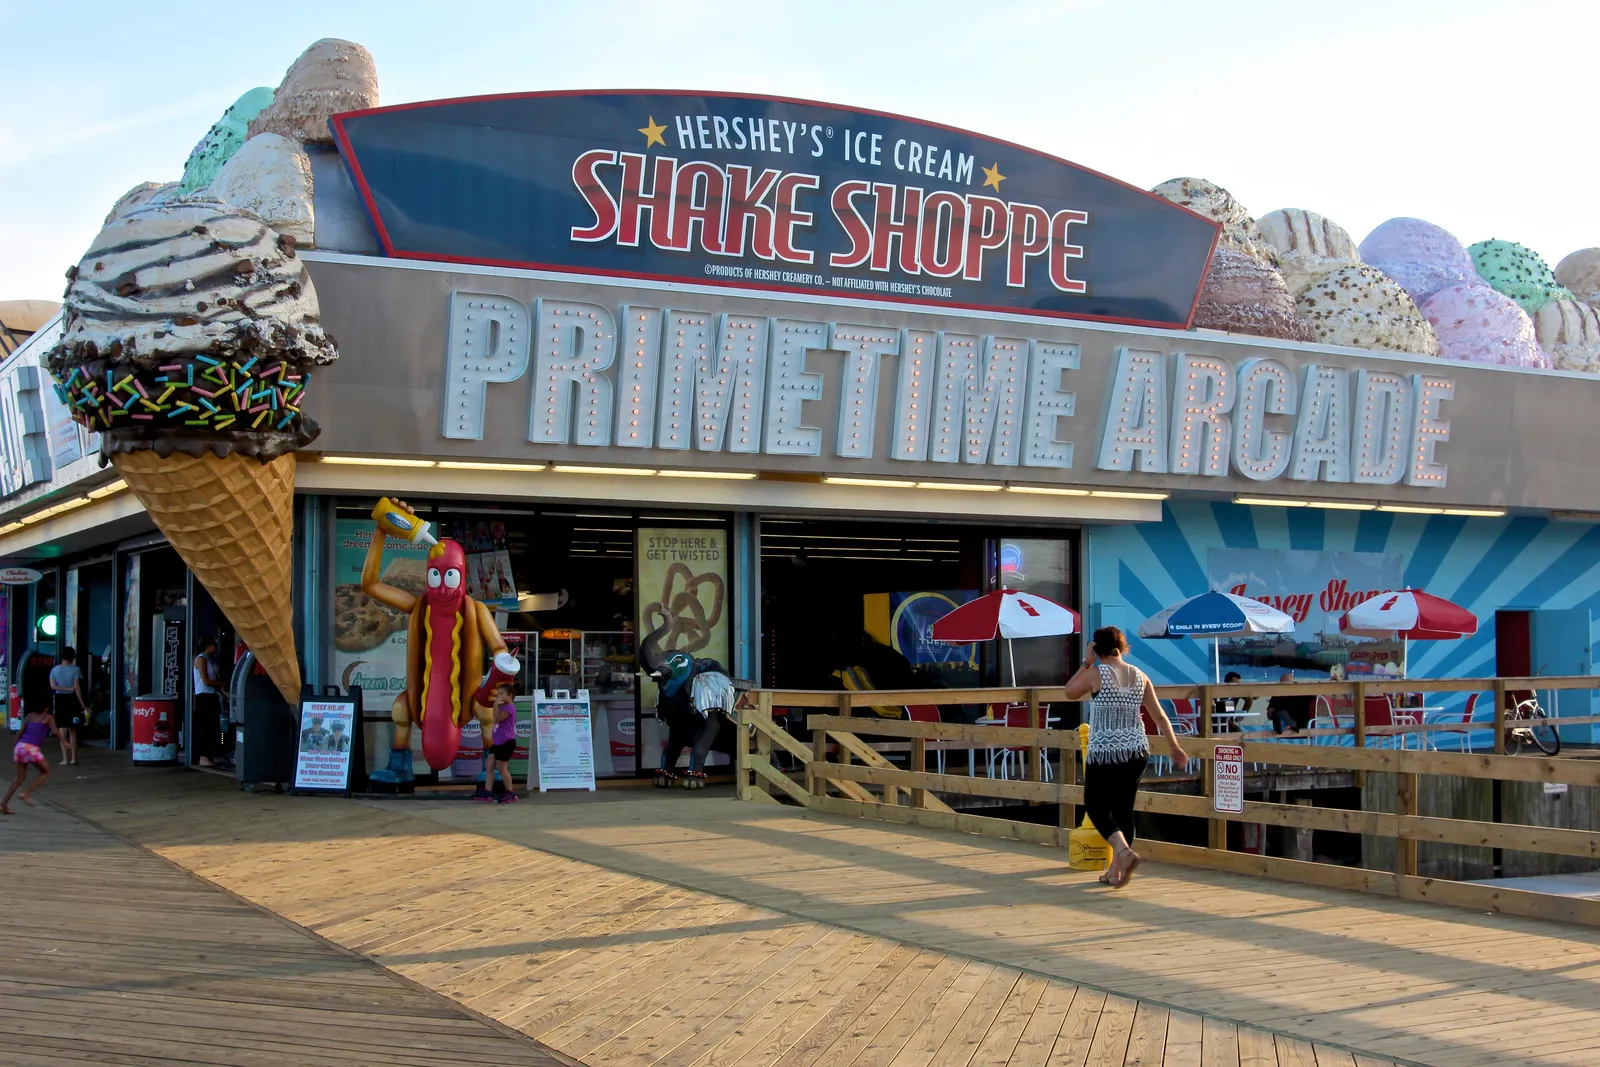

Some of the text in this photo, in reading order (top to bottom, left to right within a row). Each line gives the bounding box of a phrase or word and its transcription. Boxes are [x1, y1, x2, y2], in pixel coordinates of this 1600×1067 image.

[844, 129, 882, 166] ICE
[894, 138, 974, 186] CREAM
[570, 149, 1089, 293] SHAKE SHOPPE
[745, 268, 753, 278] OF
[754, 268, 782, 281] HERSHEY
[782, 271, 814, 284] CREAMERY
[814, 275, 824, 285] CO.
[832, 276, 843, 287] NOT
[844, 278, 874, 290] AFFILIATED
[875, 281, 889, 291] WITH
[890, 282, 920, 294] HERSHEY'S
[922, 285, 952, 298] CHOCOLATE
[1097, 347, 1456, 489] ARCADE
[646, 550, 719, 561] GET TWISTED
[649, 537, 717, 548] STOP HERE &
[1225, 764, 1238, 774] NO
